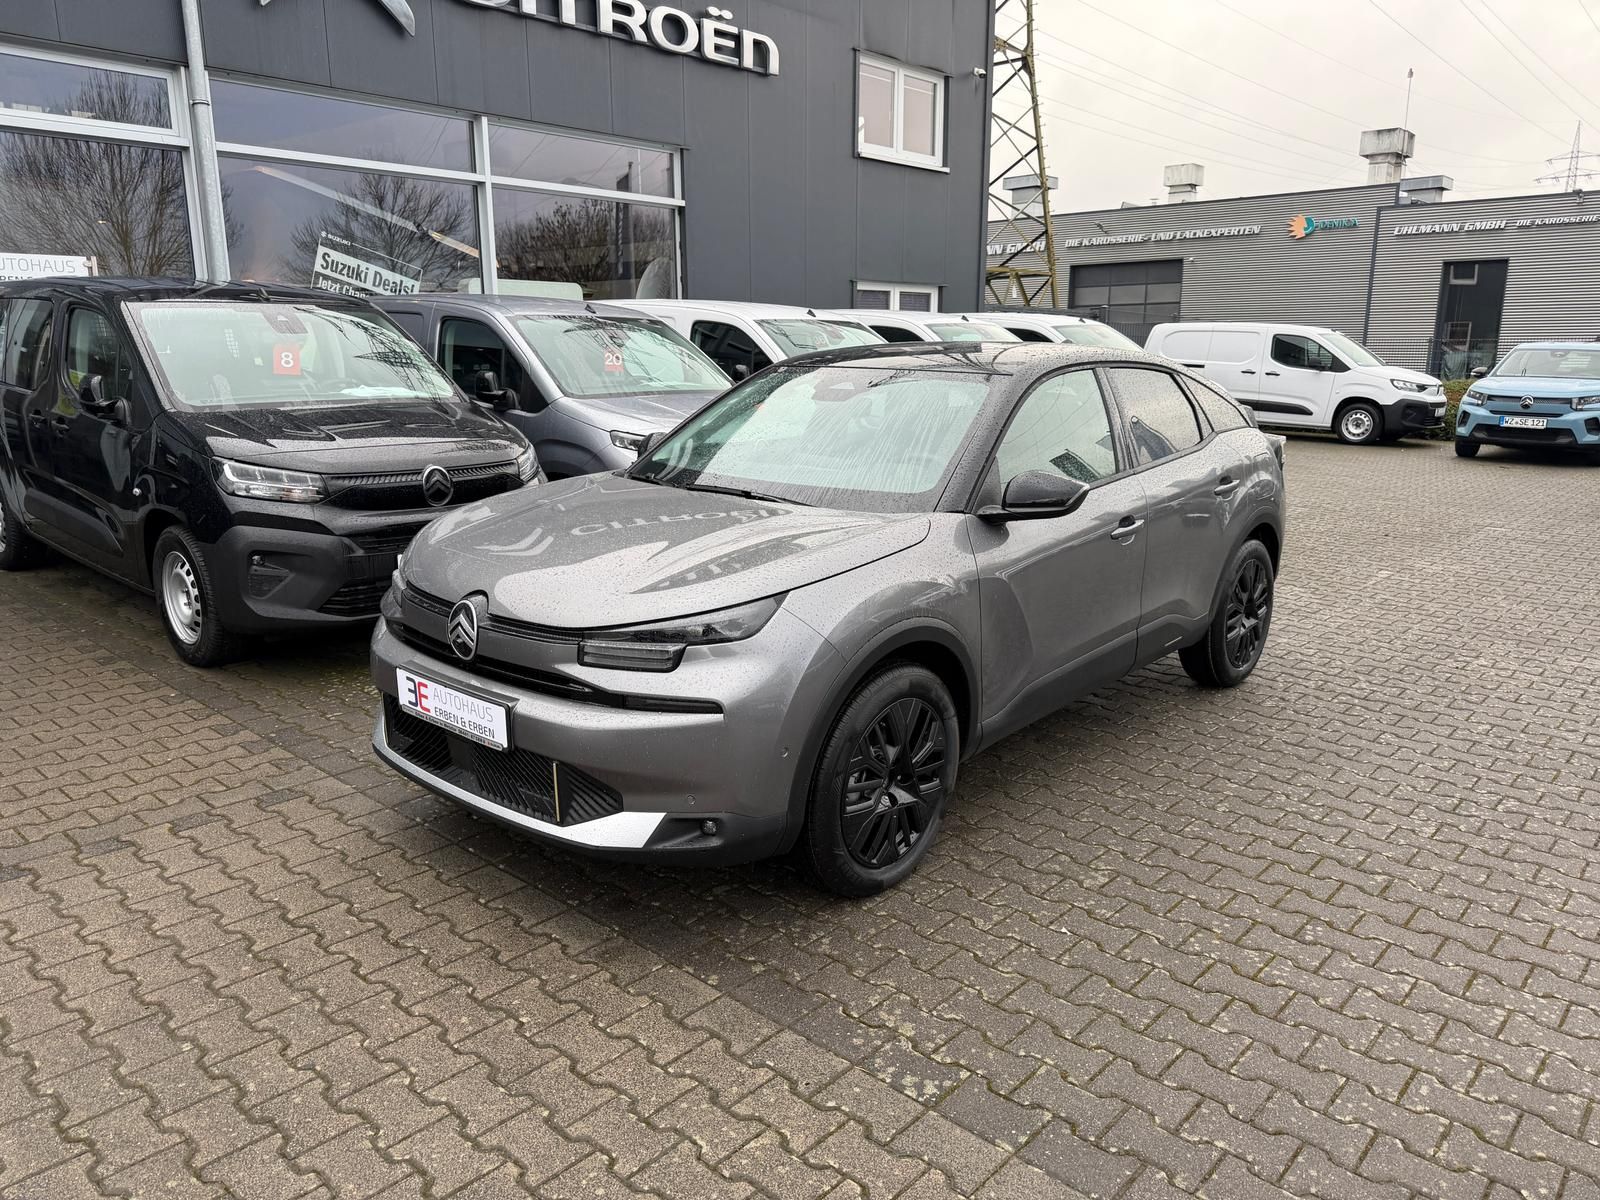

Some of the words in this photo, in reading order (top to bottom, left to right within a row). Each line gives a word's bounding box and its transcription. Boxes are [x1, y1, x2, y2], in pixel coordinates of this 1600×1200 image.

[1463, 220, 1507, 231] GMBH
[320, 252, 370, 284] Suzuki
[372, 270, 415, 296] Deals!
[316, 276, 341, 294] Jetzt
[281, 351, 294, 368] 8
[604, 351, 622, 366] 20
[433, 687, 494, 723] AUTOHAUS
[434, 706, 459, 725] ERBEN
[460, 717, 468, 729] &
[468, 720, 495, 739] ERBEN
